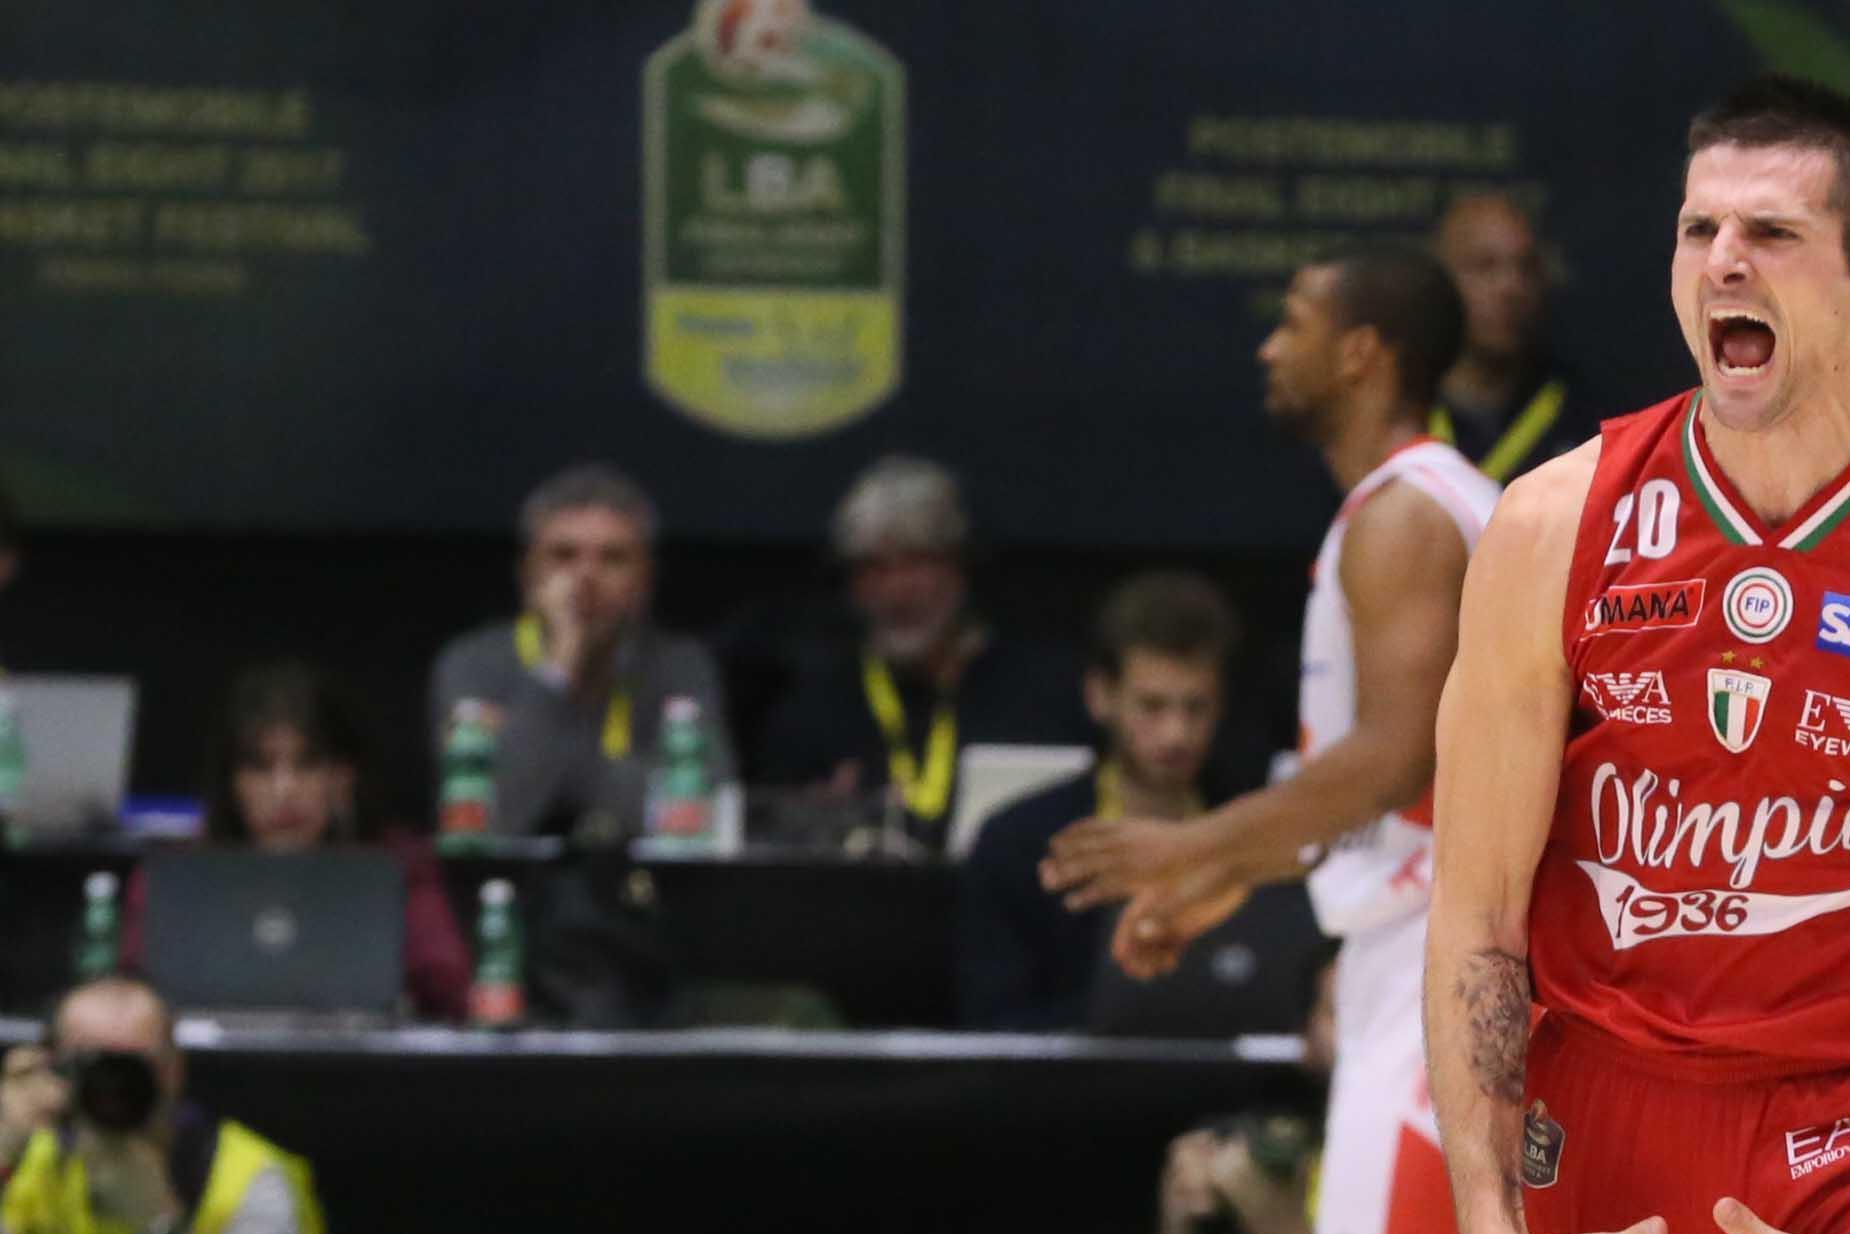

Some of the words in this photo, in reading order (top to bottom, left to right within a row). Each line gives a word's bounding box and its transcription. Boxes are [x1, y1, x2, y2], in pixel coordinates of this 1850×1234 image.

[1604, 479, 1681, 567] 20
[1745, 596, 1770, 614] FIP
[1614, 884, 1751, 940] 1936
